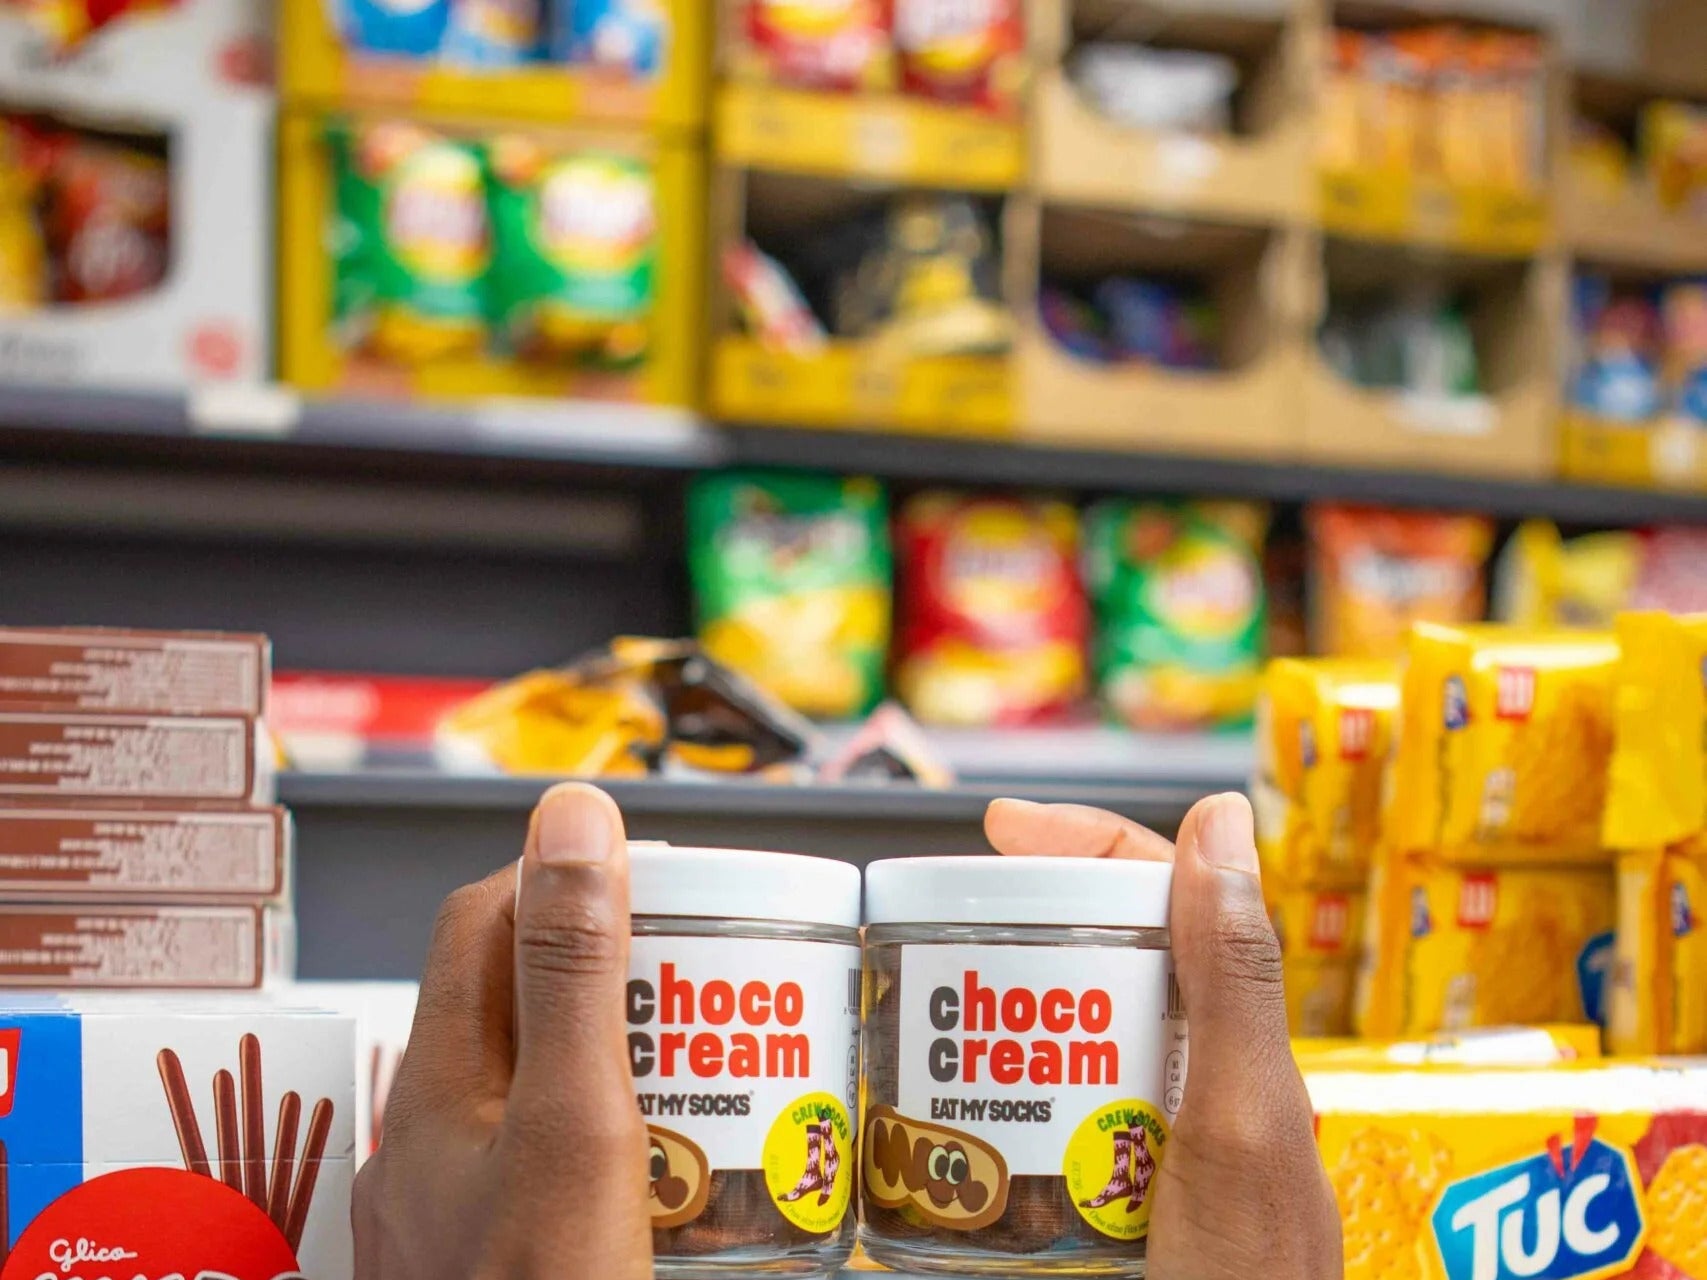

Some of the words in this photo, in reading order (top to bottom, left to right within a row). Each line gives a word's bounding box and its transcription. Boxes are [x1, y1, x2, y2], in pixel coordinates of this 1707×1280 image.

[626, 962, 804, 1027] choco
[929, 970, 1113, 1034] choco
[627, 1031, 810, 1079] cream
[928, 1037, 1119, 1086] cream
[637, 1093, 657, 1116] AT
[658, 1094, 688, 1116] MY
[689, 1094, 751, 1116] SOCKS
[792, 1102, 824, 1125] CREW
[930, 1097, 959, 1121] EAT
[960, 1099, 988, 1121] MY
[988, 1099, 1052, 1123] SOCKS
[1097, 1108, 1134, 1132] CREW
[1136, 1109, 1166, 1147] SOCKS
[49, 1237, 138, 1273] Glico
